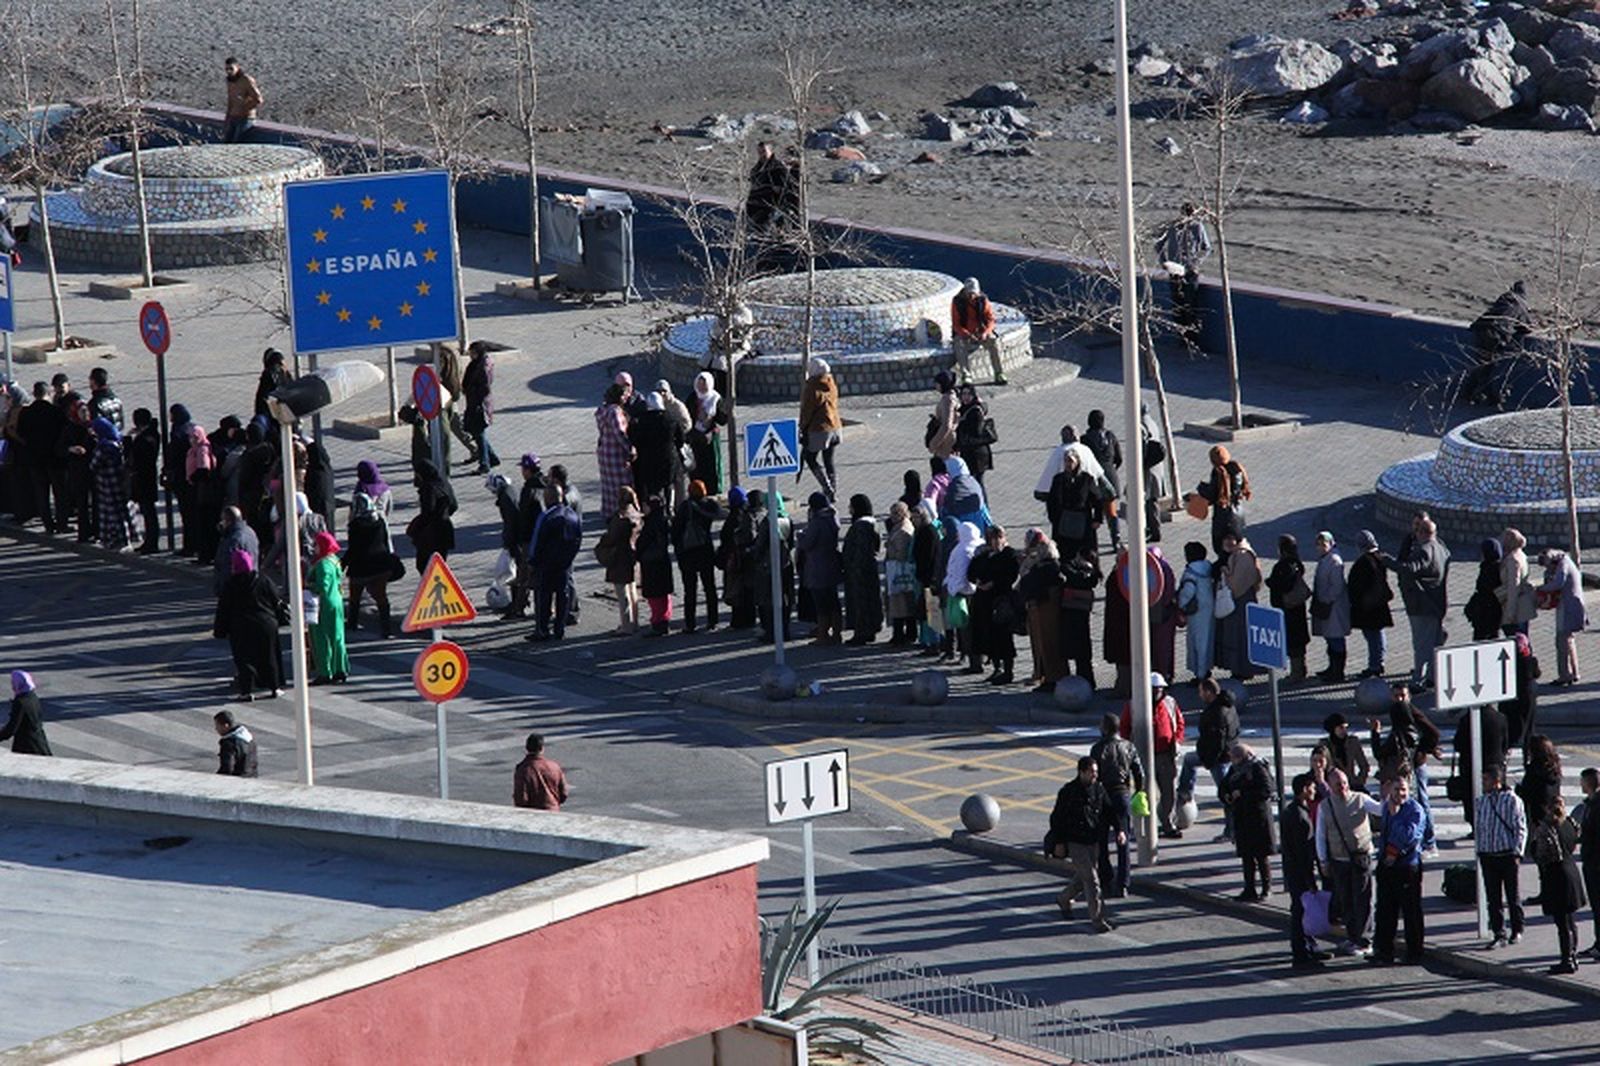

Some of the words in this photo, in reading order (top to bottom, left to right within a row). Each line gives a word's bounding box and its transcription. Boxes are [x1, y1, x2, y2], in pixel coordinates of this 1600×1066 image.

[325, 248, 418, 275] ESPAÑA
[1250, 625, 1281, 649] TAXI
[427, 661, 456, 684] 30
